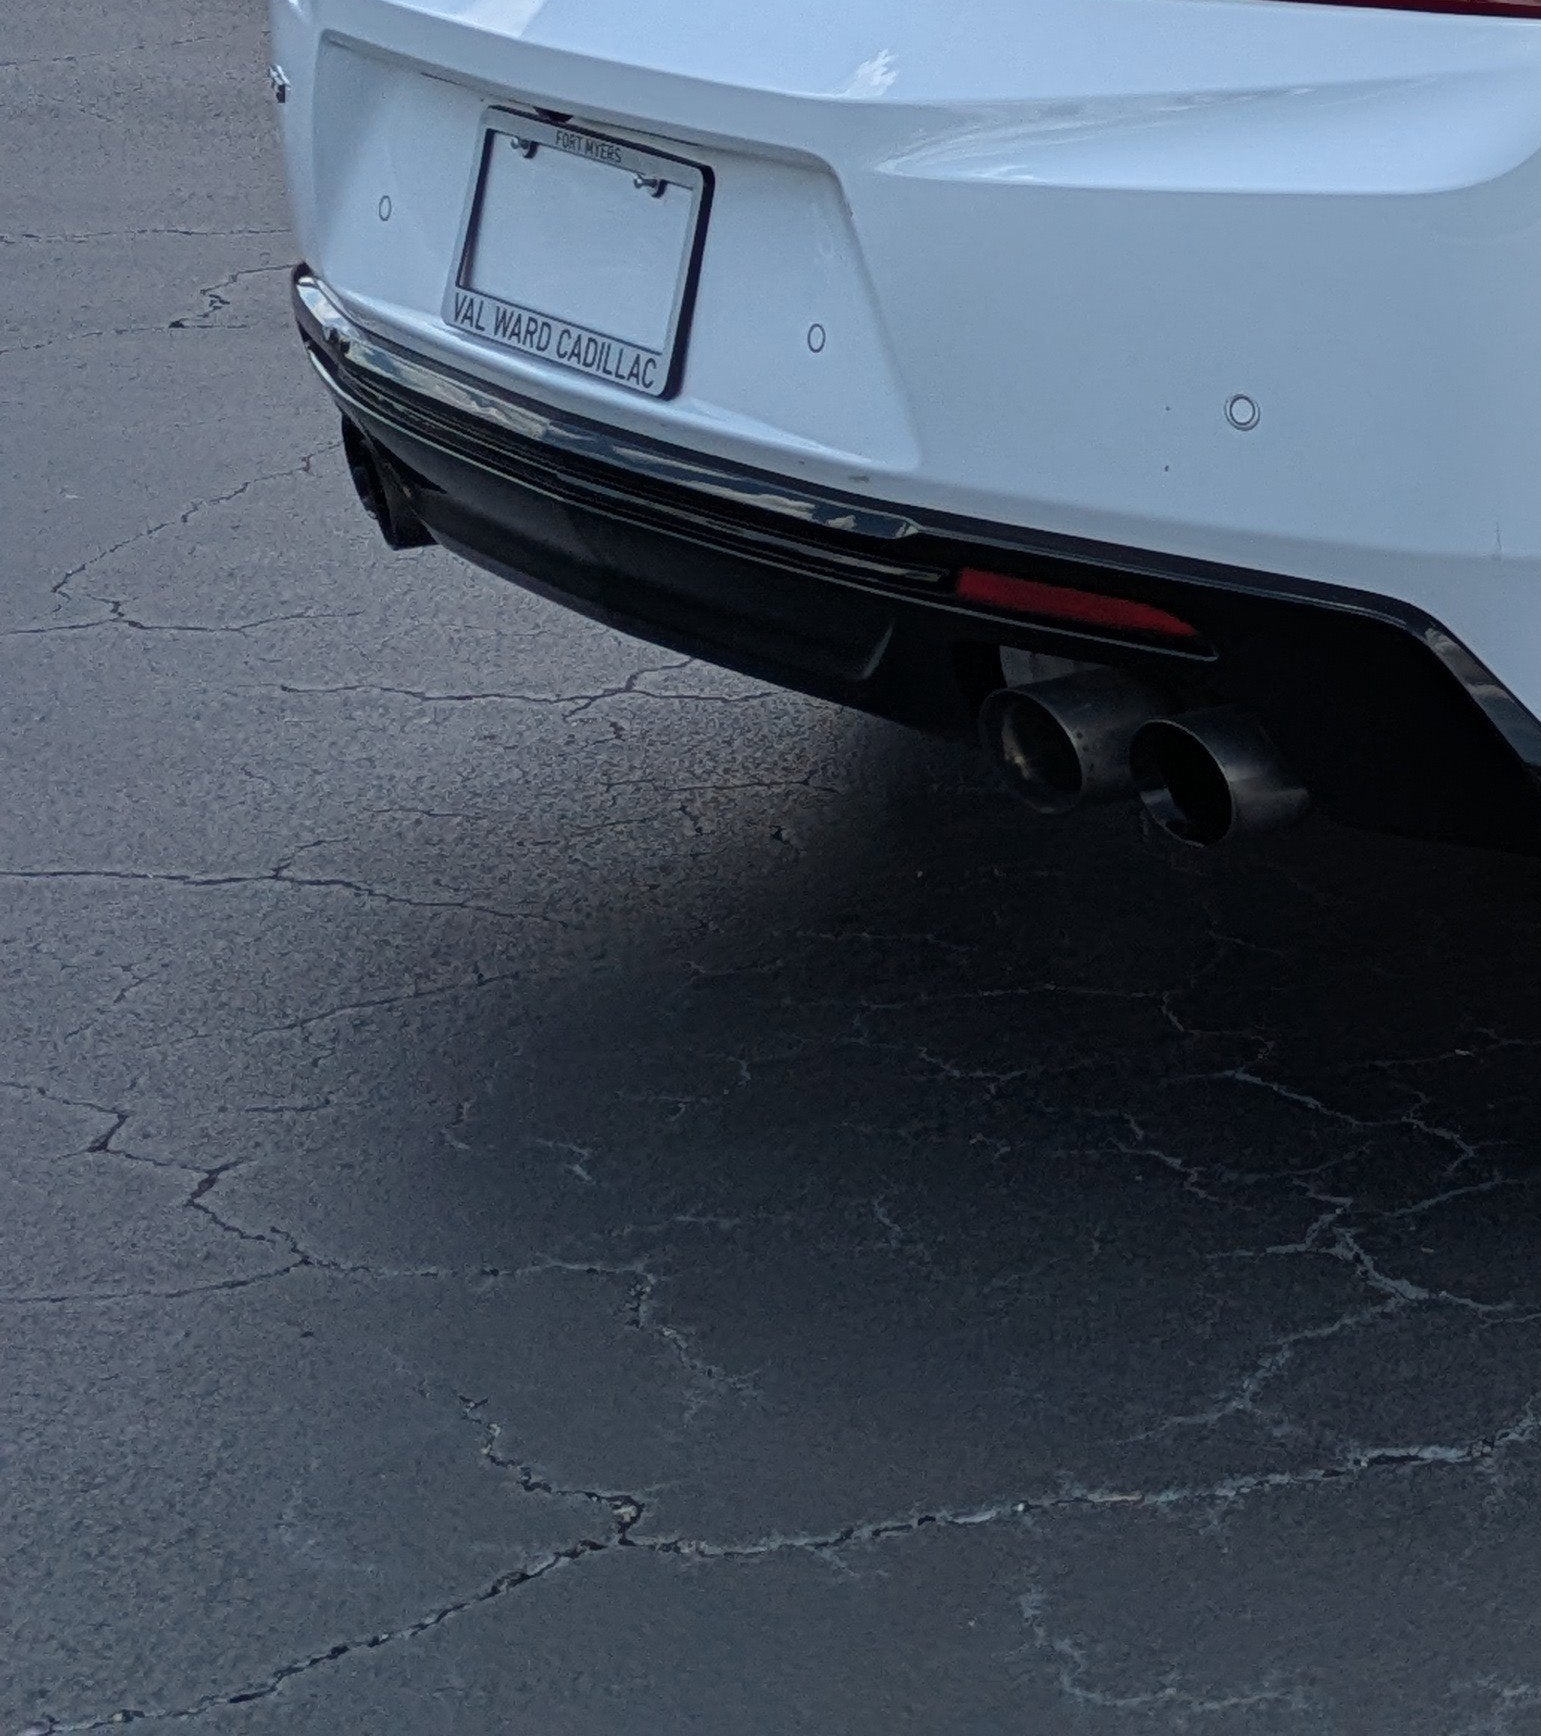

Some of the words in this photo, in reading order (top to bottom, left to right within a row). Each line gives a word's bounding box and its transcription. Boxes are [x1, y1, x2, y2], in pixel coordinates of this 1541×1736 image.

[555, 130, 582, 154] FORT
[584, 138, 623, 164] MYERS
[453, 292, 486, 332] VAL
[493, 306, 552, 353] WARD
[555, 329, 657, 389] CADILLAC
